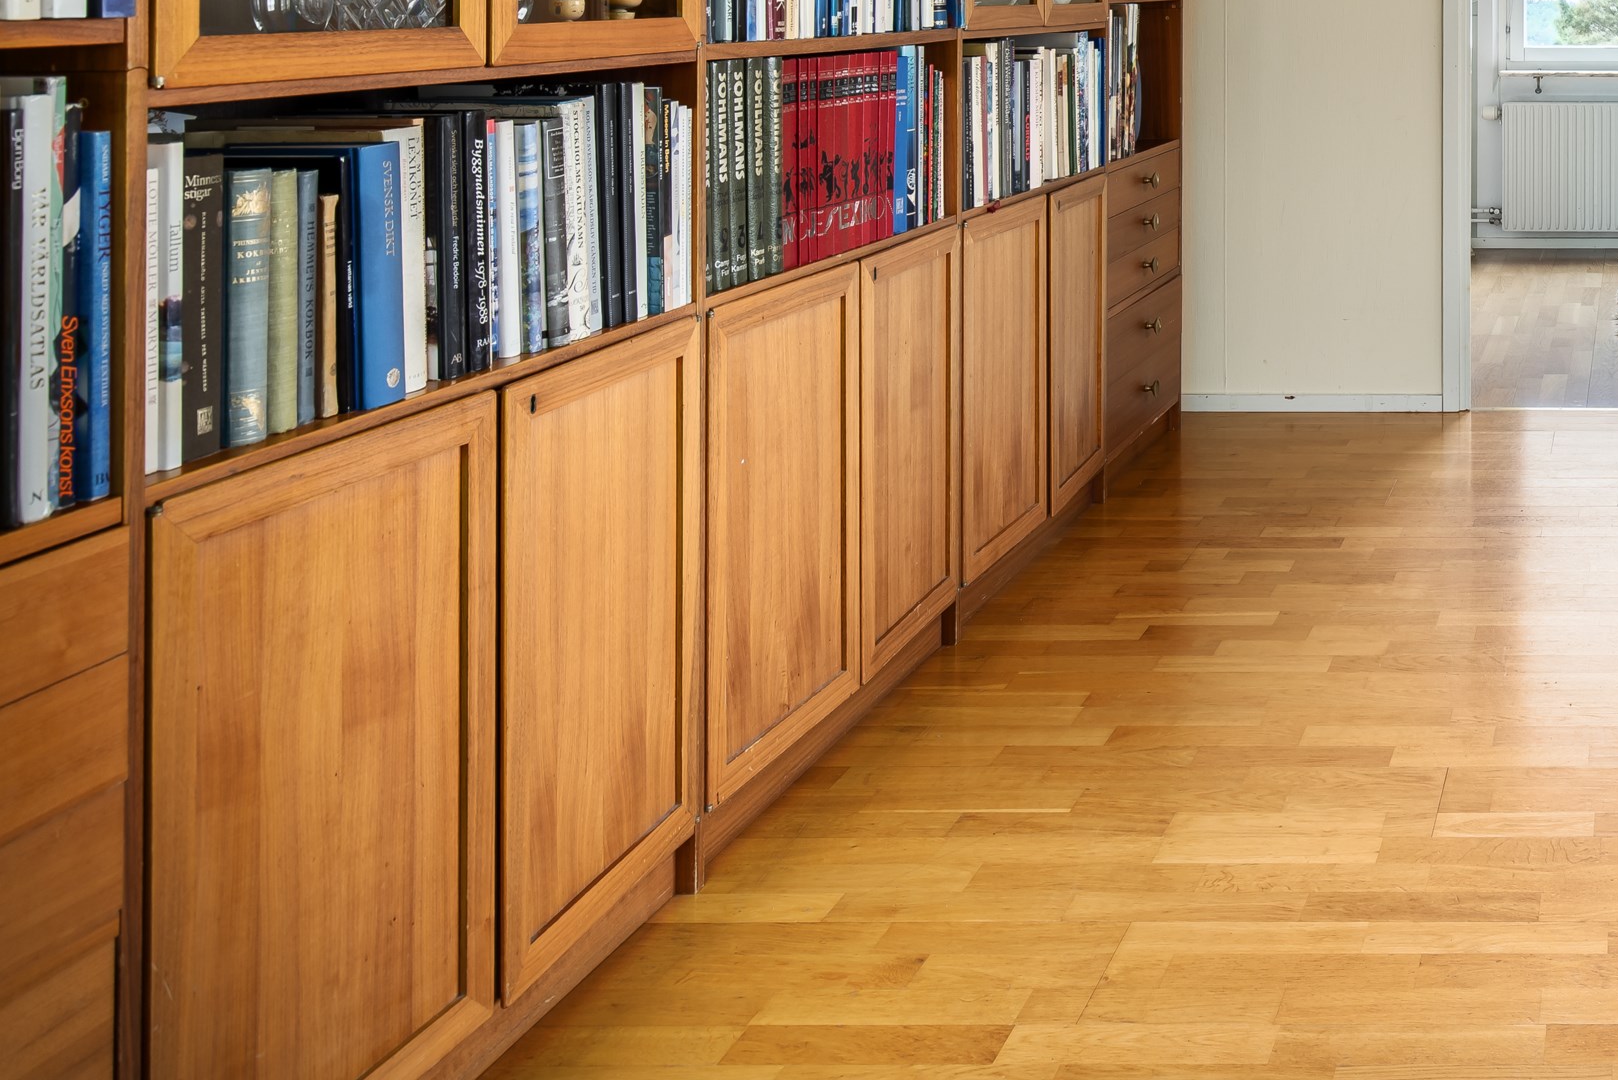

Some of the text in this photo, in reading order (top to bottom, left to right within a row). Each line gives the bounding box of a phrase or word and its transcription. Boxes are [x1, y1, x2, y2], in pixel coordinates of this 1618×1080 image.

[718, 72, 728, 183] SOHLMANS
[734, 71, 745, 180] SOHLMANS
[754, 70, 764, 176] SOHLMANS
[98, 188, 111, 263] TYGER
[383, 160, 395, 256] SVENSK DIKT
[407, 137, 418, 220] LEXIKONET
[472, 139, 486, 255] Byggnadsminnen
[573, 110, 584, 249] STOCKHOLMS GATUNAMN
[30, 187, 50, 390] VÅR VÄRLDSATLAS
[148, 180, 158, 290] LOTTE MÖLLER
[169, 220, 182, 272] Tallum
[452, 236, 460, 289] Fredric Bedoire
[304, 221, 315, 360] HEMMETS KOKBOK
[147, 311, 158, 391] MARYHILL
[59, 315, 78, 497] Sven Erixsons konst
